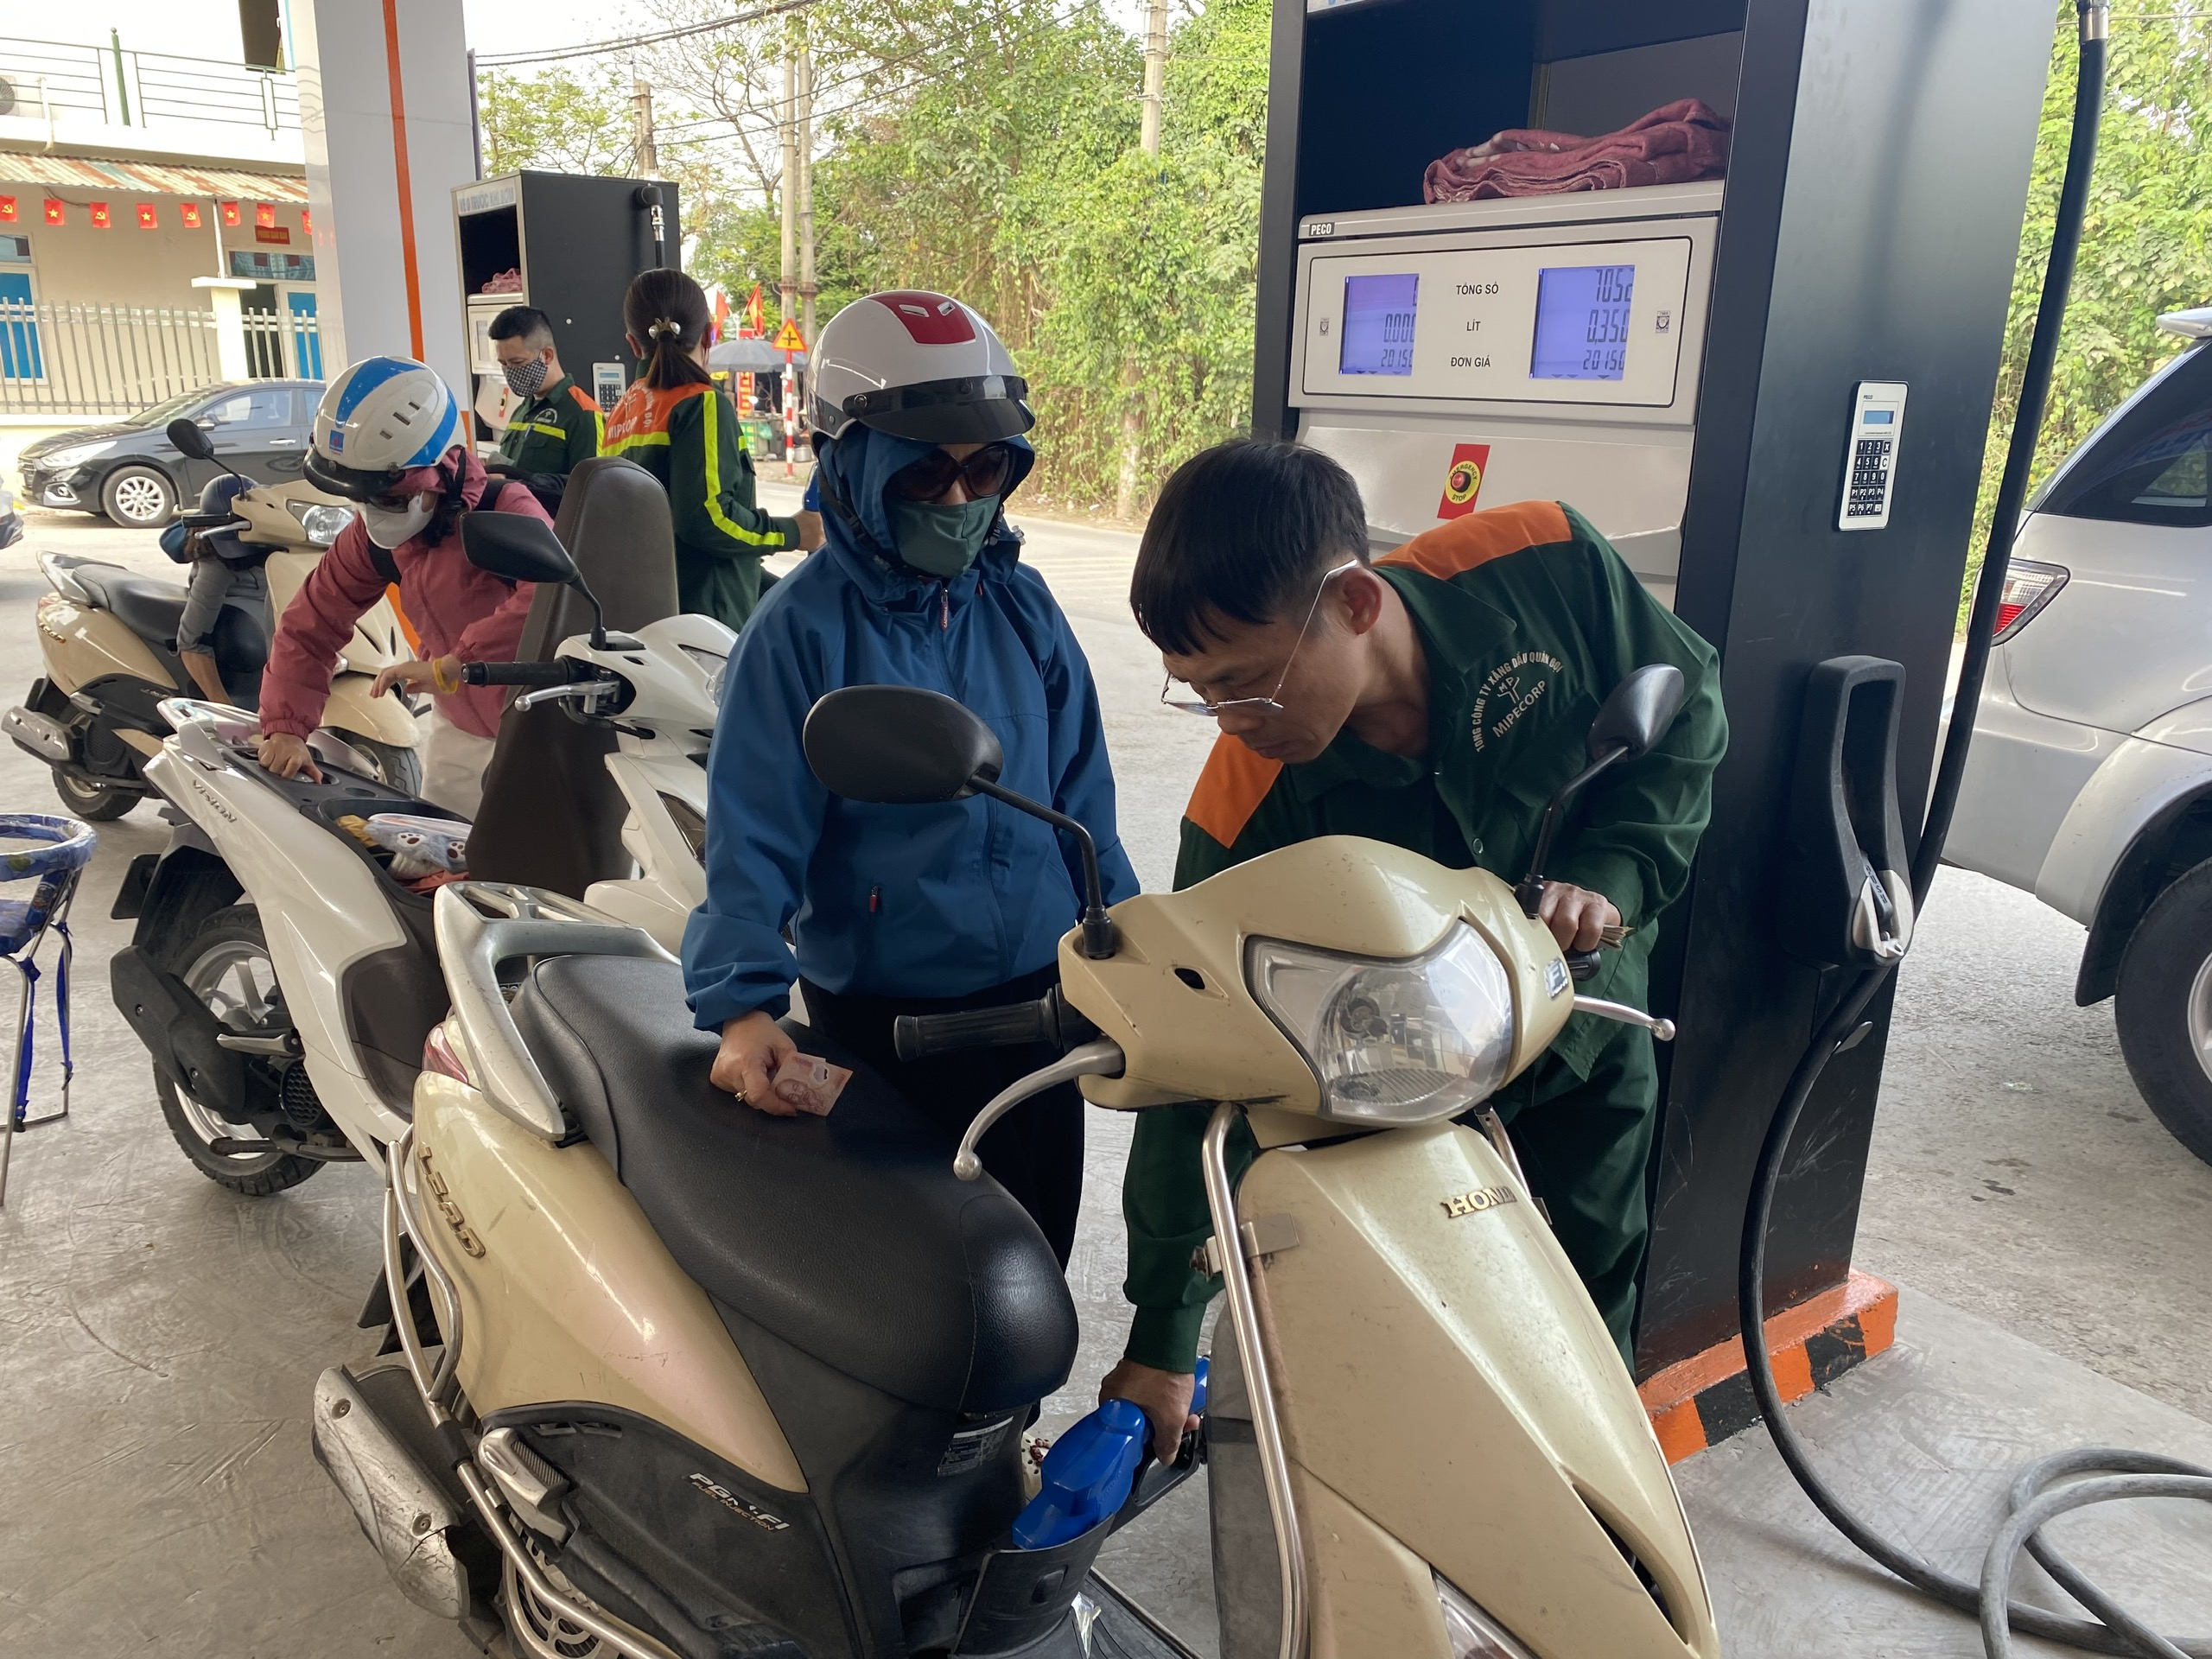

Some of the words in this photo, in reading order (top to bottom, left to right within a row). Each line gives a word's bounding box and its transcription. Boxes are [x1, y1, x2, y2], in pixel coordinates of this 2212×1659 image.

[1311, 223, 1332, 235] PECO
[1466, 318, 1481, 331] LÍT
[1474, 354, 1491, 367] GIÁ
[1882, 457, 1888, 467] C
[1452, 493, 1466, 502] STOP
[1471, 697, 1486, 725] CÔNG
[1479, 683, 1491, 696] TY
[1492, 680, 1546, 738] MIPECORP
[193, 779, 238, 823] VISION
[1866, 865, 1888, 904] PUSH
[691, 1481, 719, 1500] FUEL
[720, 1498, 775, 1531] INJECTION
